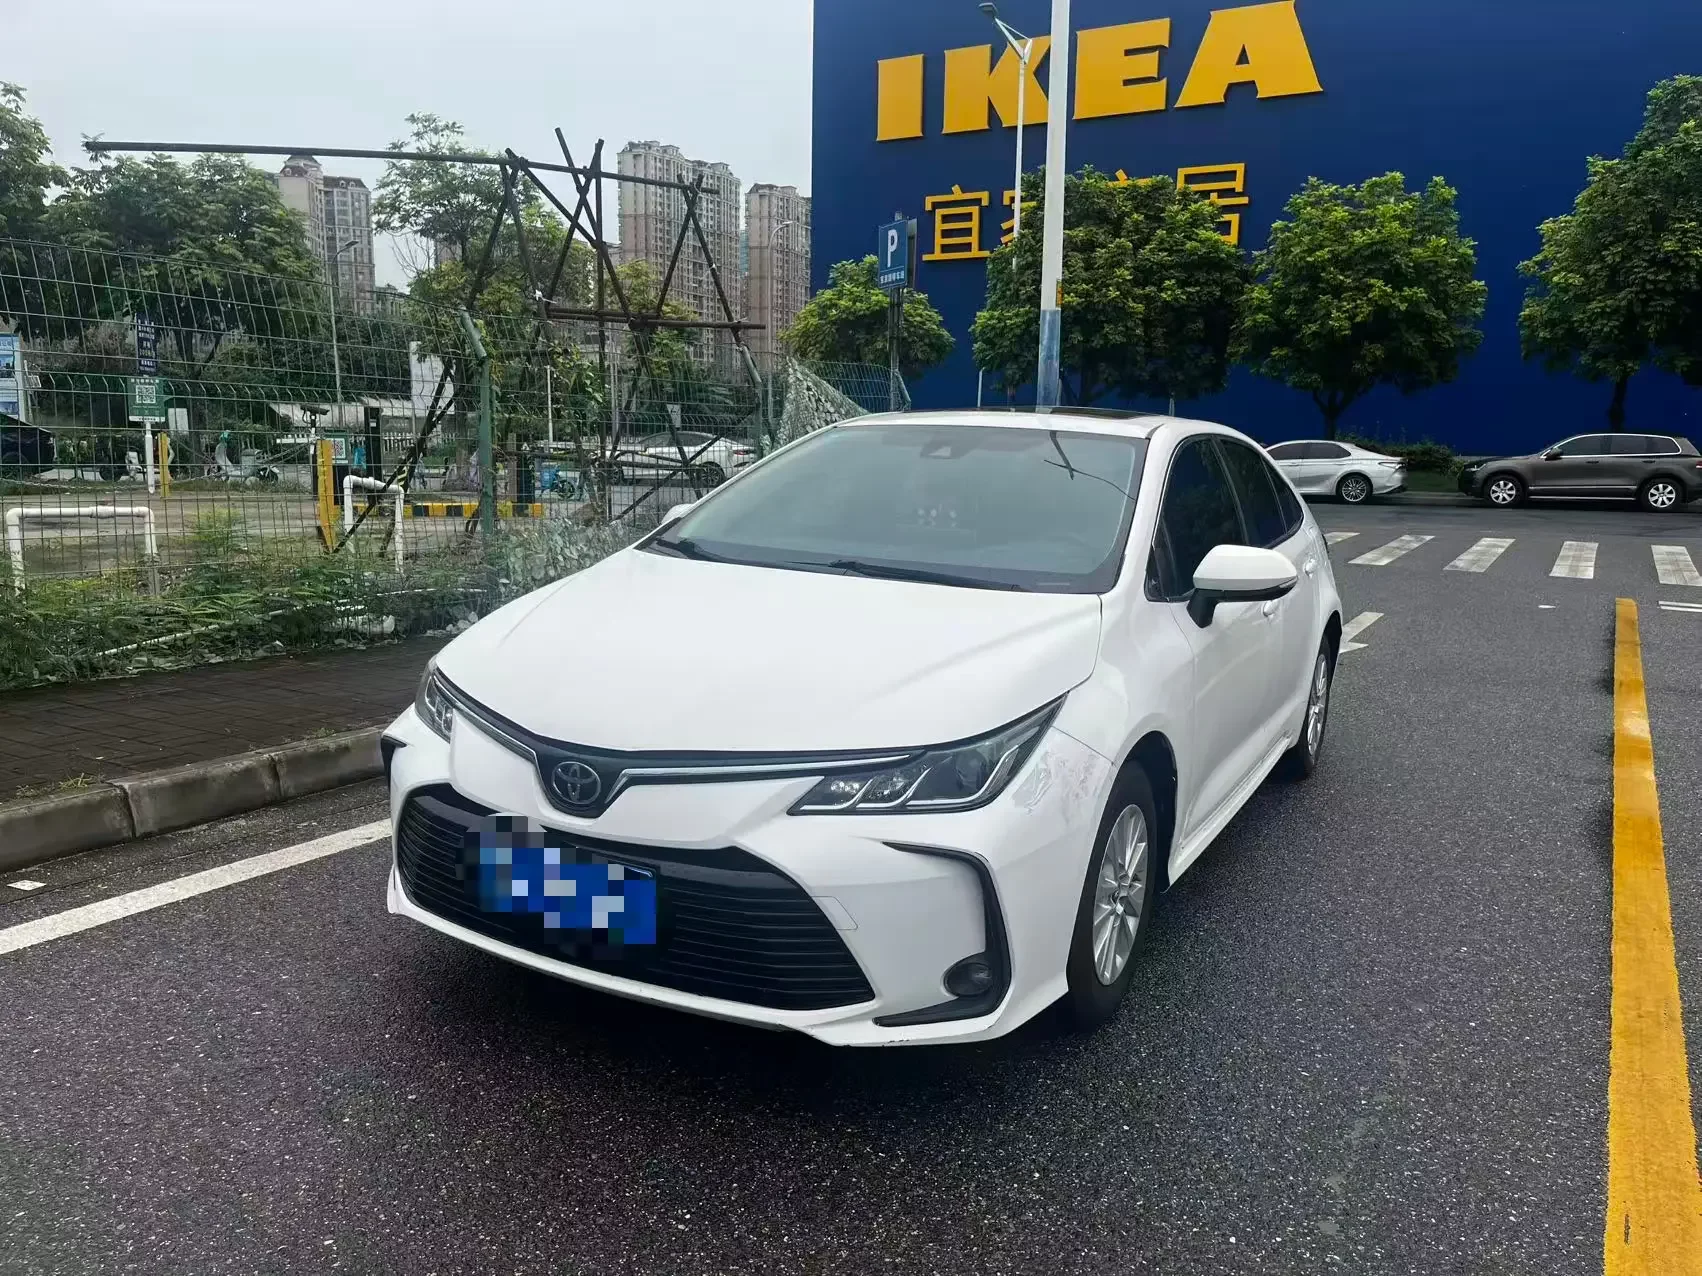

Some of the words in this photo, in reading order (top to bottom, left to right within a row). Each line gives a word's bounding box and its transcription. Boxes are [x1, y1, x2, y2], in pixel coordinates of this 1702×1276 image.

[876, 0, 1323, 142] IKEA
[887, 229, 899, 268] P
[922, 162, 1249, 262] 宜居
